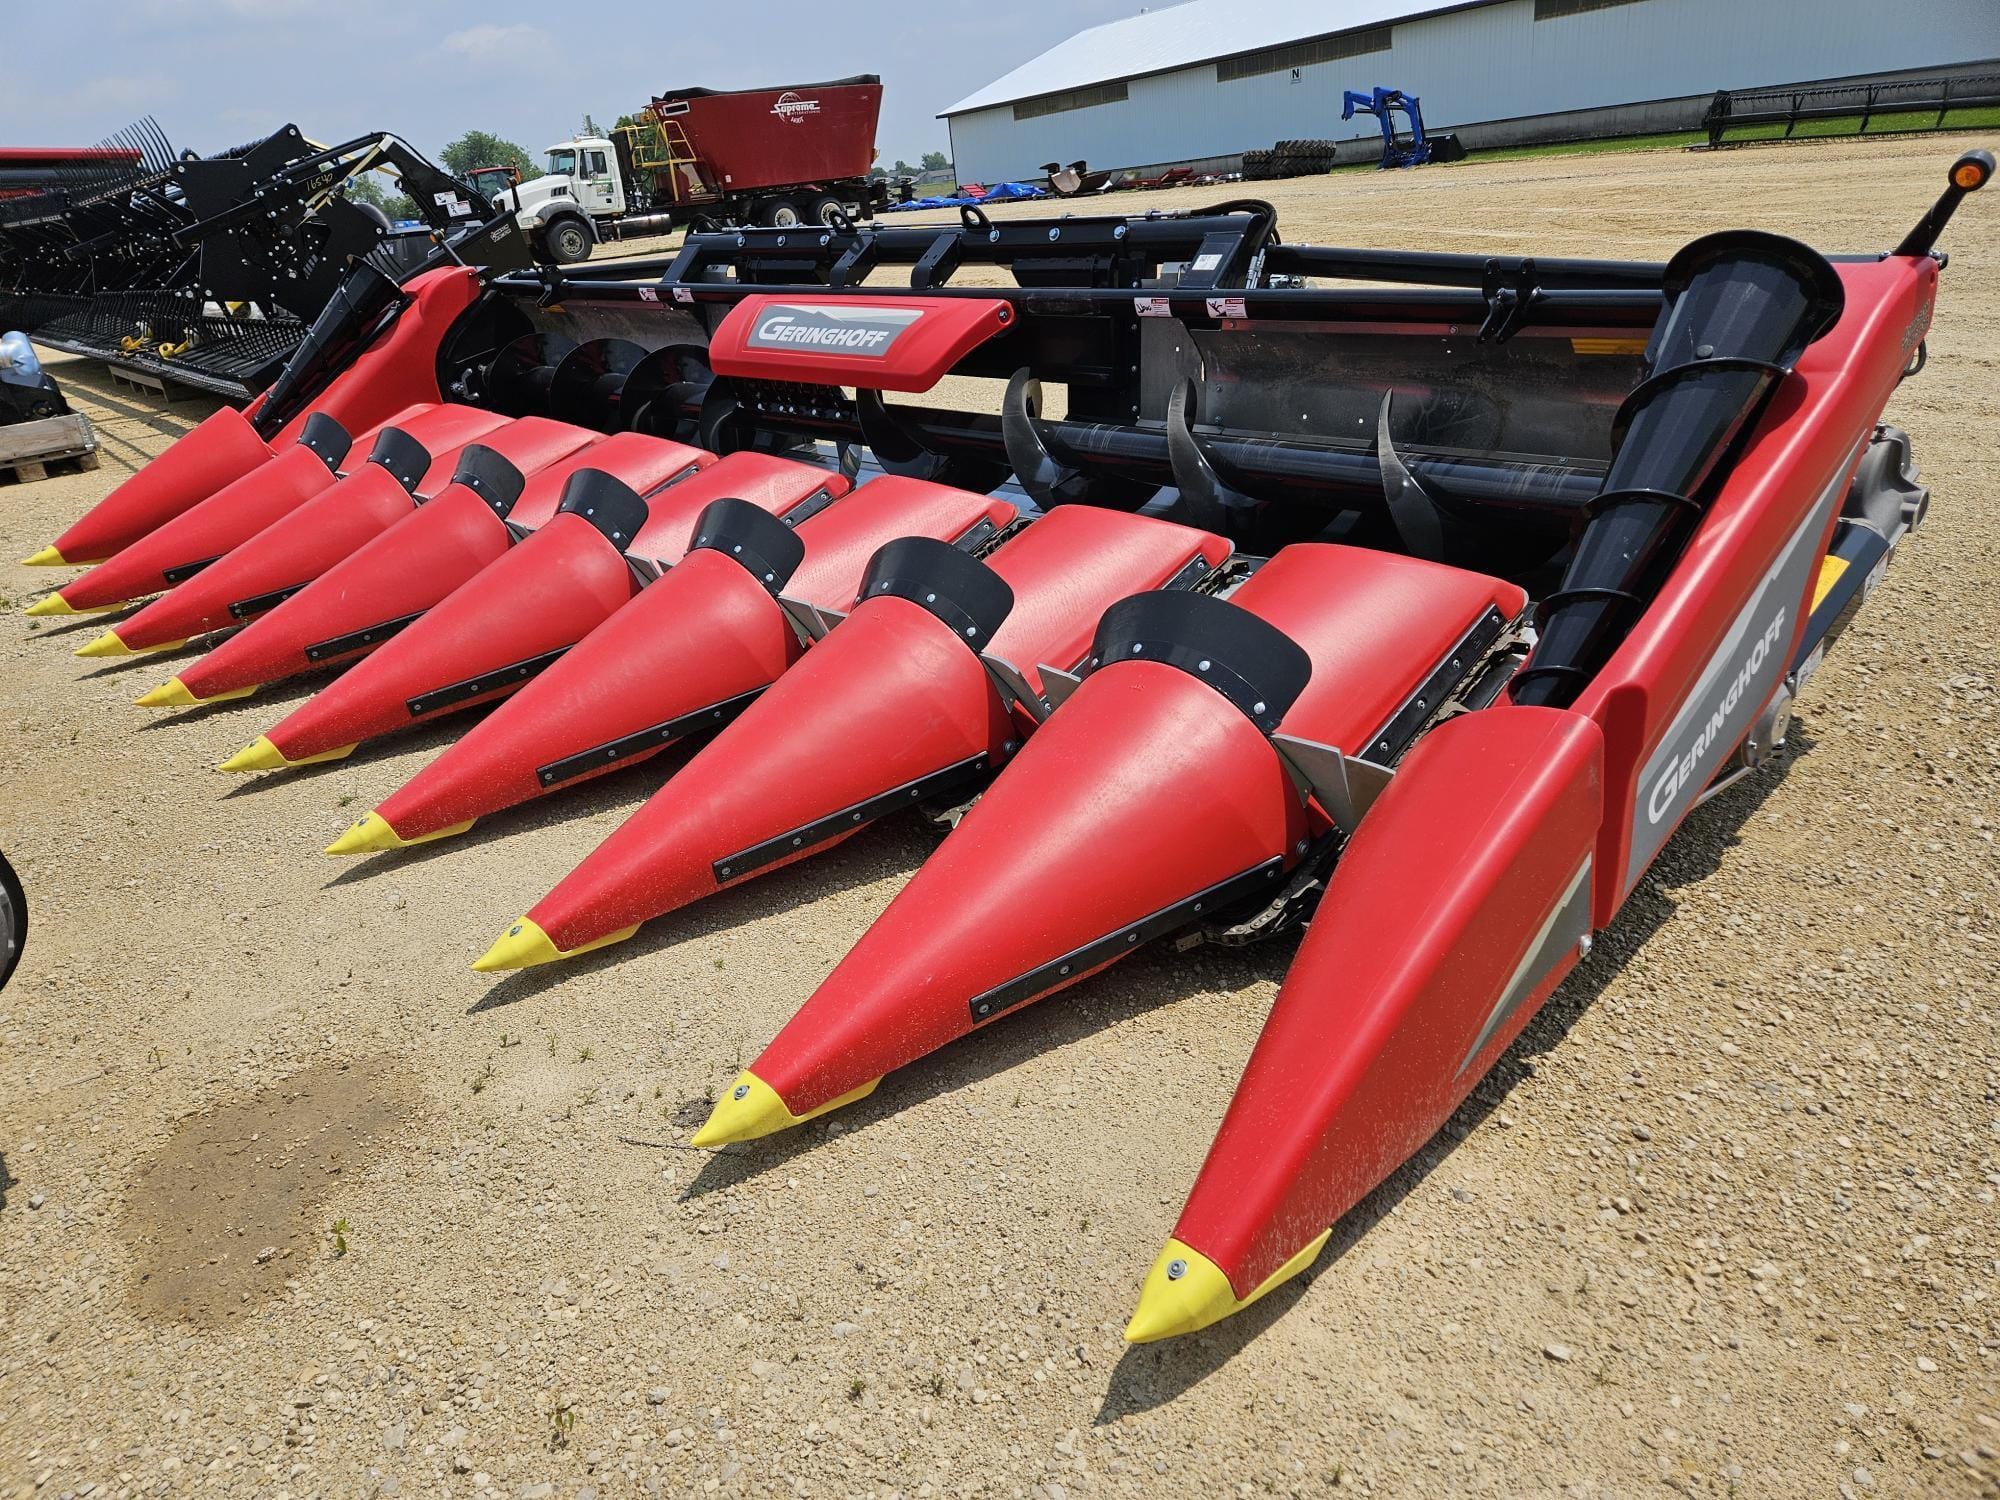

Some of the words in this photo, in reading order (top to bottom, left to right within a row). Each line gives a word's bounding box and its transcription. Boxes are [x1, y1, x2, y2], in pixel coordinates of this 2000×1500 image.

[1292, 68, 1300, 79] N
[770, 100, 820, 116] Supreme
[306, 173, 333, 192] 16540
[759, 316, 890, 347] GERINGHOFF
[1649, 606, 1785, 824] GERINGHOFF
